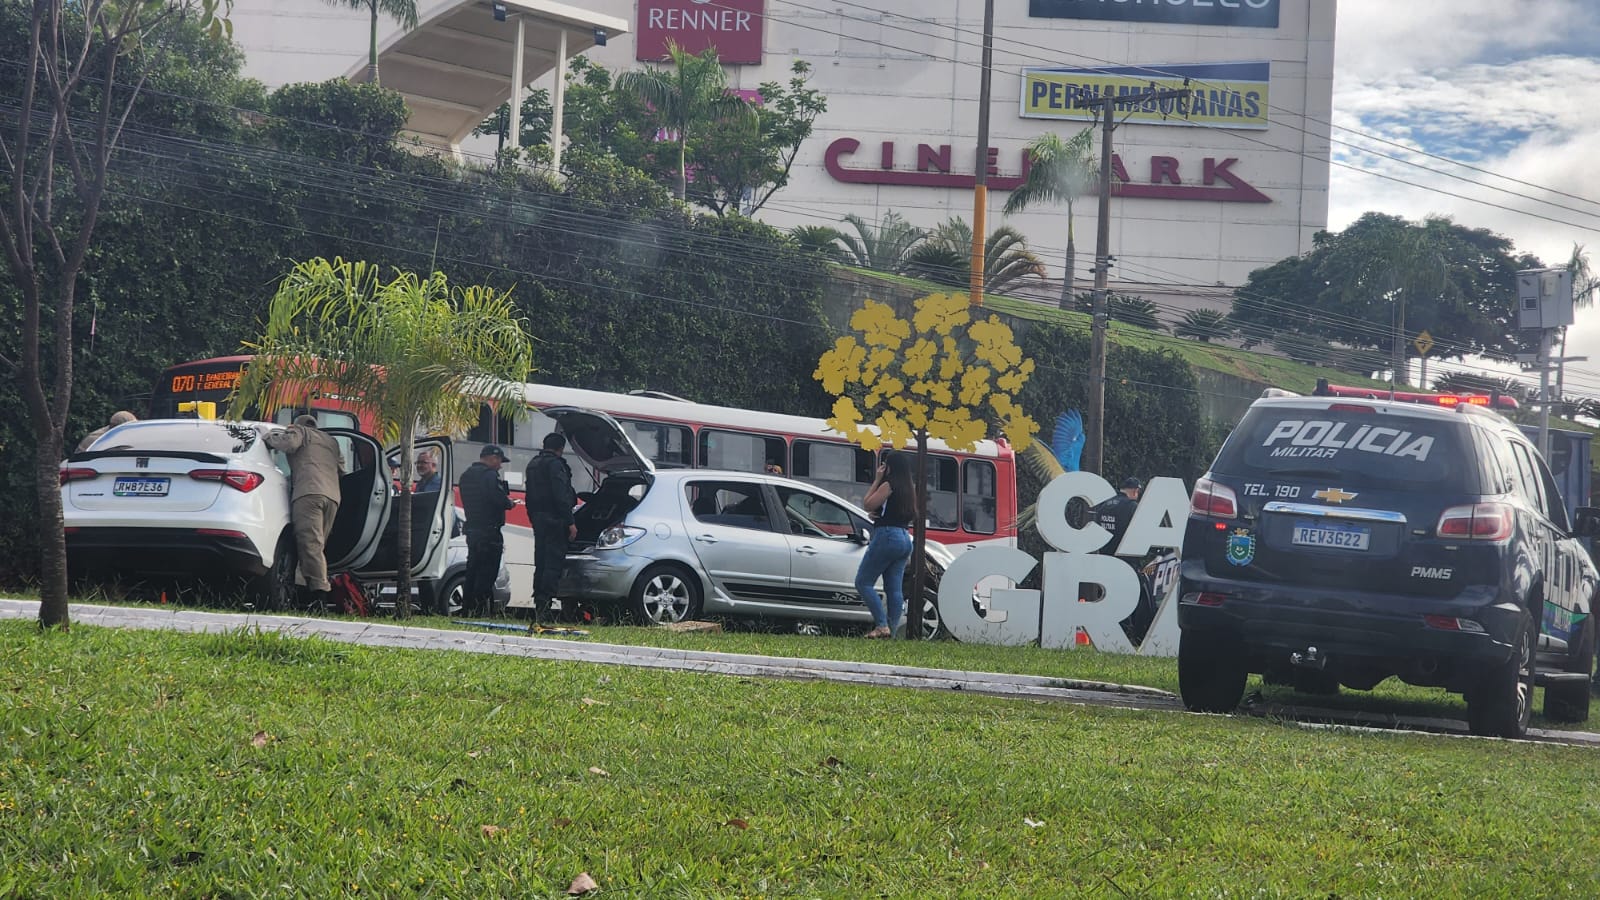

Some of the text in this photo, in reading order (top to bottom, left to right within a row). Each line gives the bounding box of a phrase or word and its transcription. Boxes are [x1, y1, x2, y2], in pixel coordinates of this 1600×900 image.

[648, 8, 751, 31] RENNER
[824, 137, 1274, 203] CINEARK
[172, 375, 195, 392] 070
[1263, 421, 1434, 462] POLICIA
[1270, 447, 1338, 459] MILITAR
[1244, 483, 1300, 498] TEL. 190
[1300, 528, 1361, 547] REW3G22
[1411, 566, 1453, 579] PMMS
